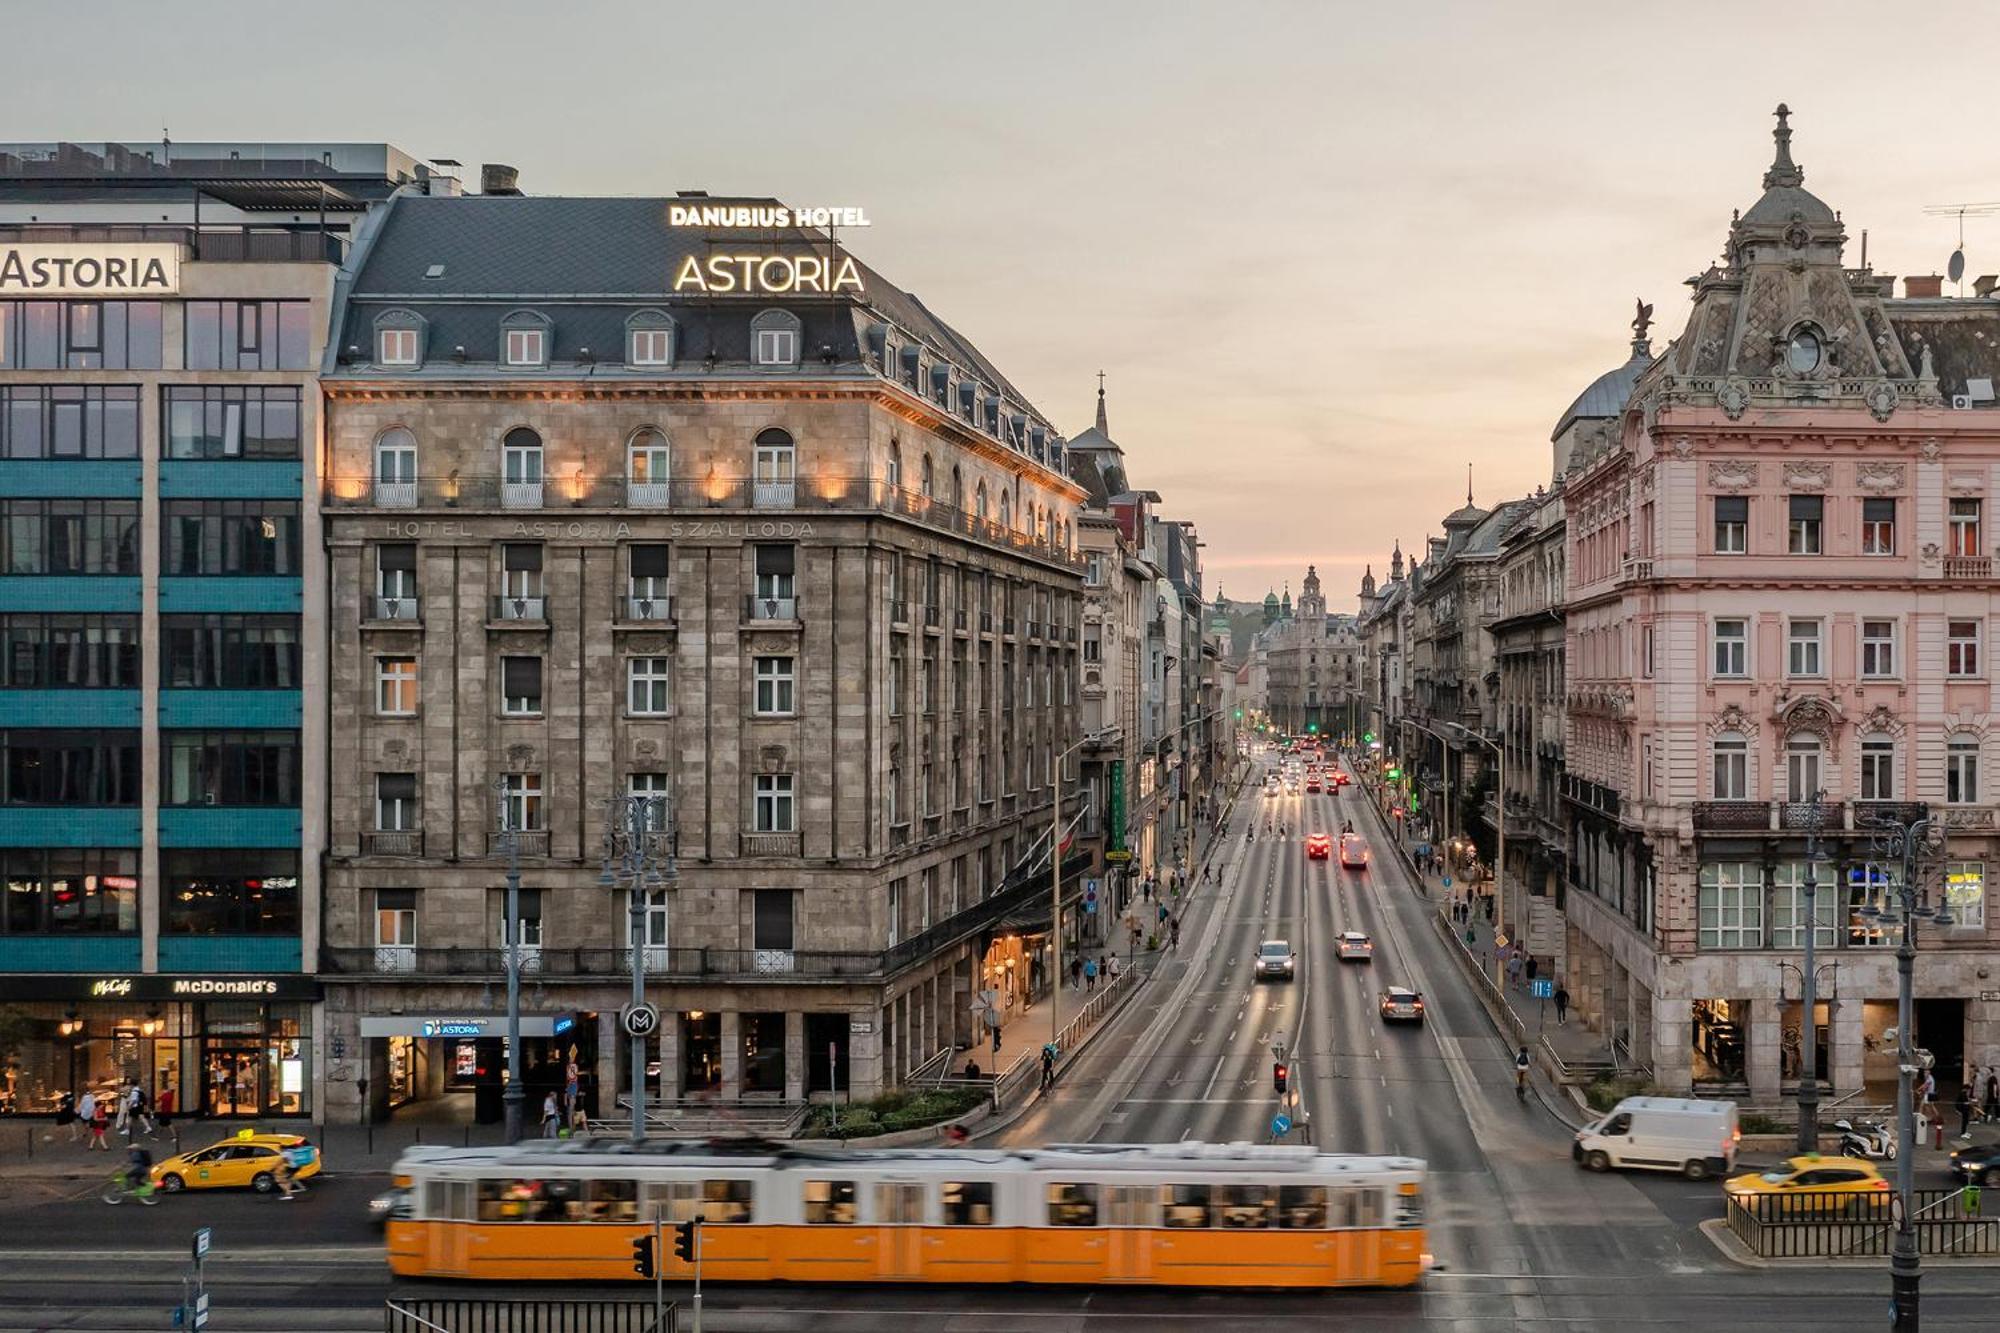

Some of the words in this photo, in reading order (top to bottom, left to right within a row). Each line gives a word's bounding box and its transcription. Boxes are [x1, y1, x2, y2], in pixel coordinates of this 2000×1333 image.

[670, 206, 790, 227] DANUBIUS
[795, 207, 871, 226] HOTEL
[0, 249, 170, 288] ASTORIA
[674, 255, 865, 292] ASTORIA
[385, 521, 473, 538] HOTEL
[512, 521, 632, 538] ASTORIA
[174, 980, 278, 994] McDonald's
[442, 1026, 479, 1035] ASTORIA
